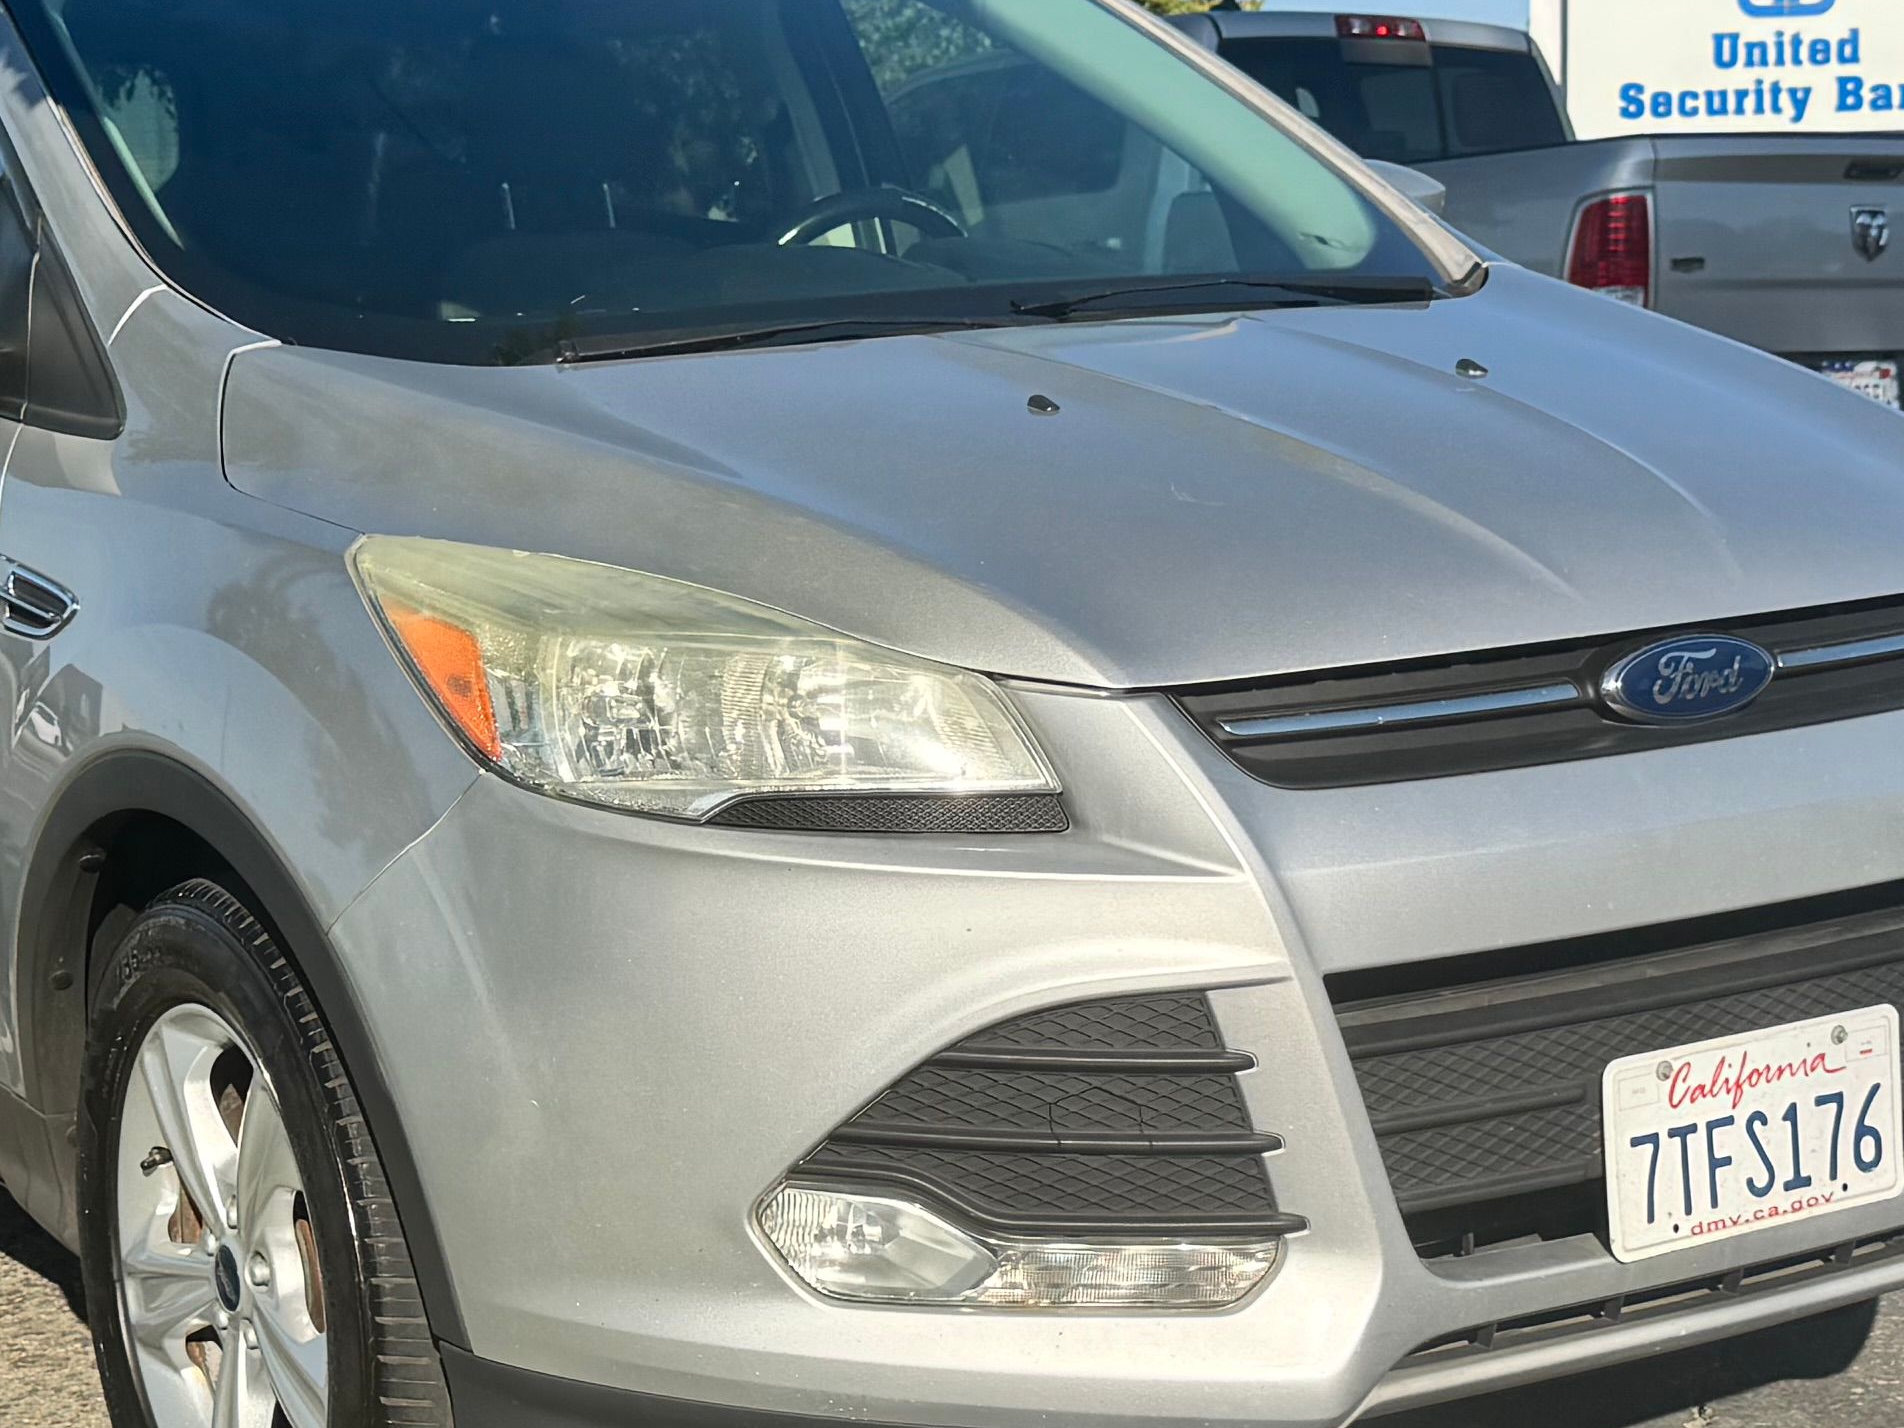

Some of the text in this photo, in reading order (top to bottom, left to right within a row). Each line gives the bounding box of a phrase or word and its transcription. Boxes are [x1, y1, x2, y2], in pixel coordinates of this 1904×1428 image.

[1711, 28, 1861, 70] United
[1618, 79, 1812, 123] Security
[1652, 647, 1746, 705] Ford
[1667, 1050, 1848, 1110] California
[1629, 1082, 1883, 1225] 7TFS176
[1689, 1190, 1835, 1238] dmv.ca.gov
